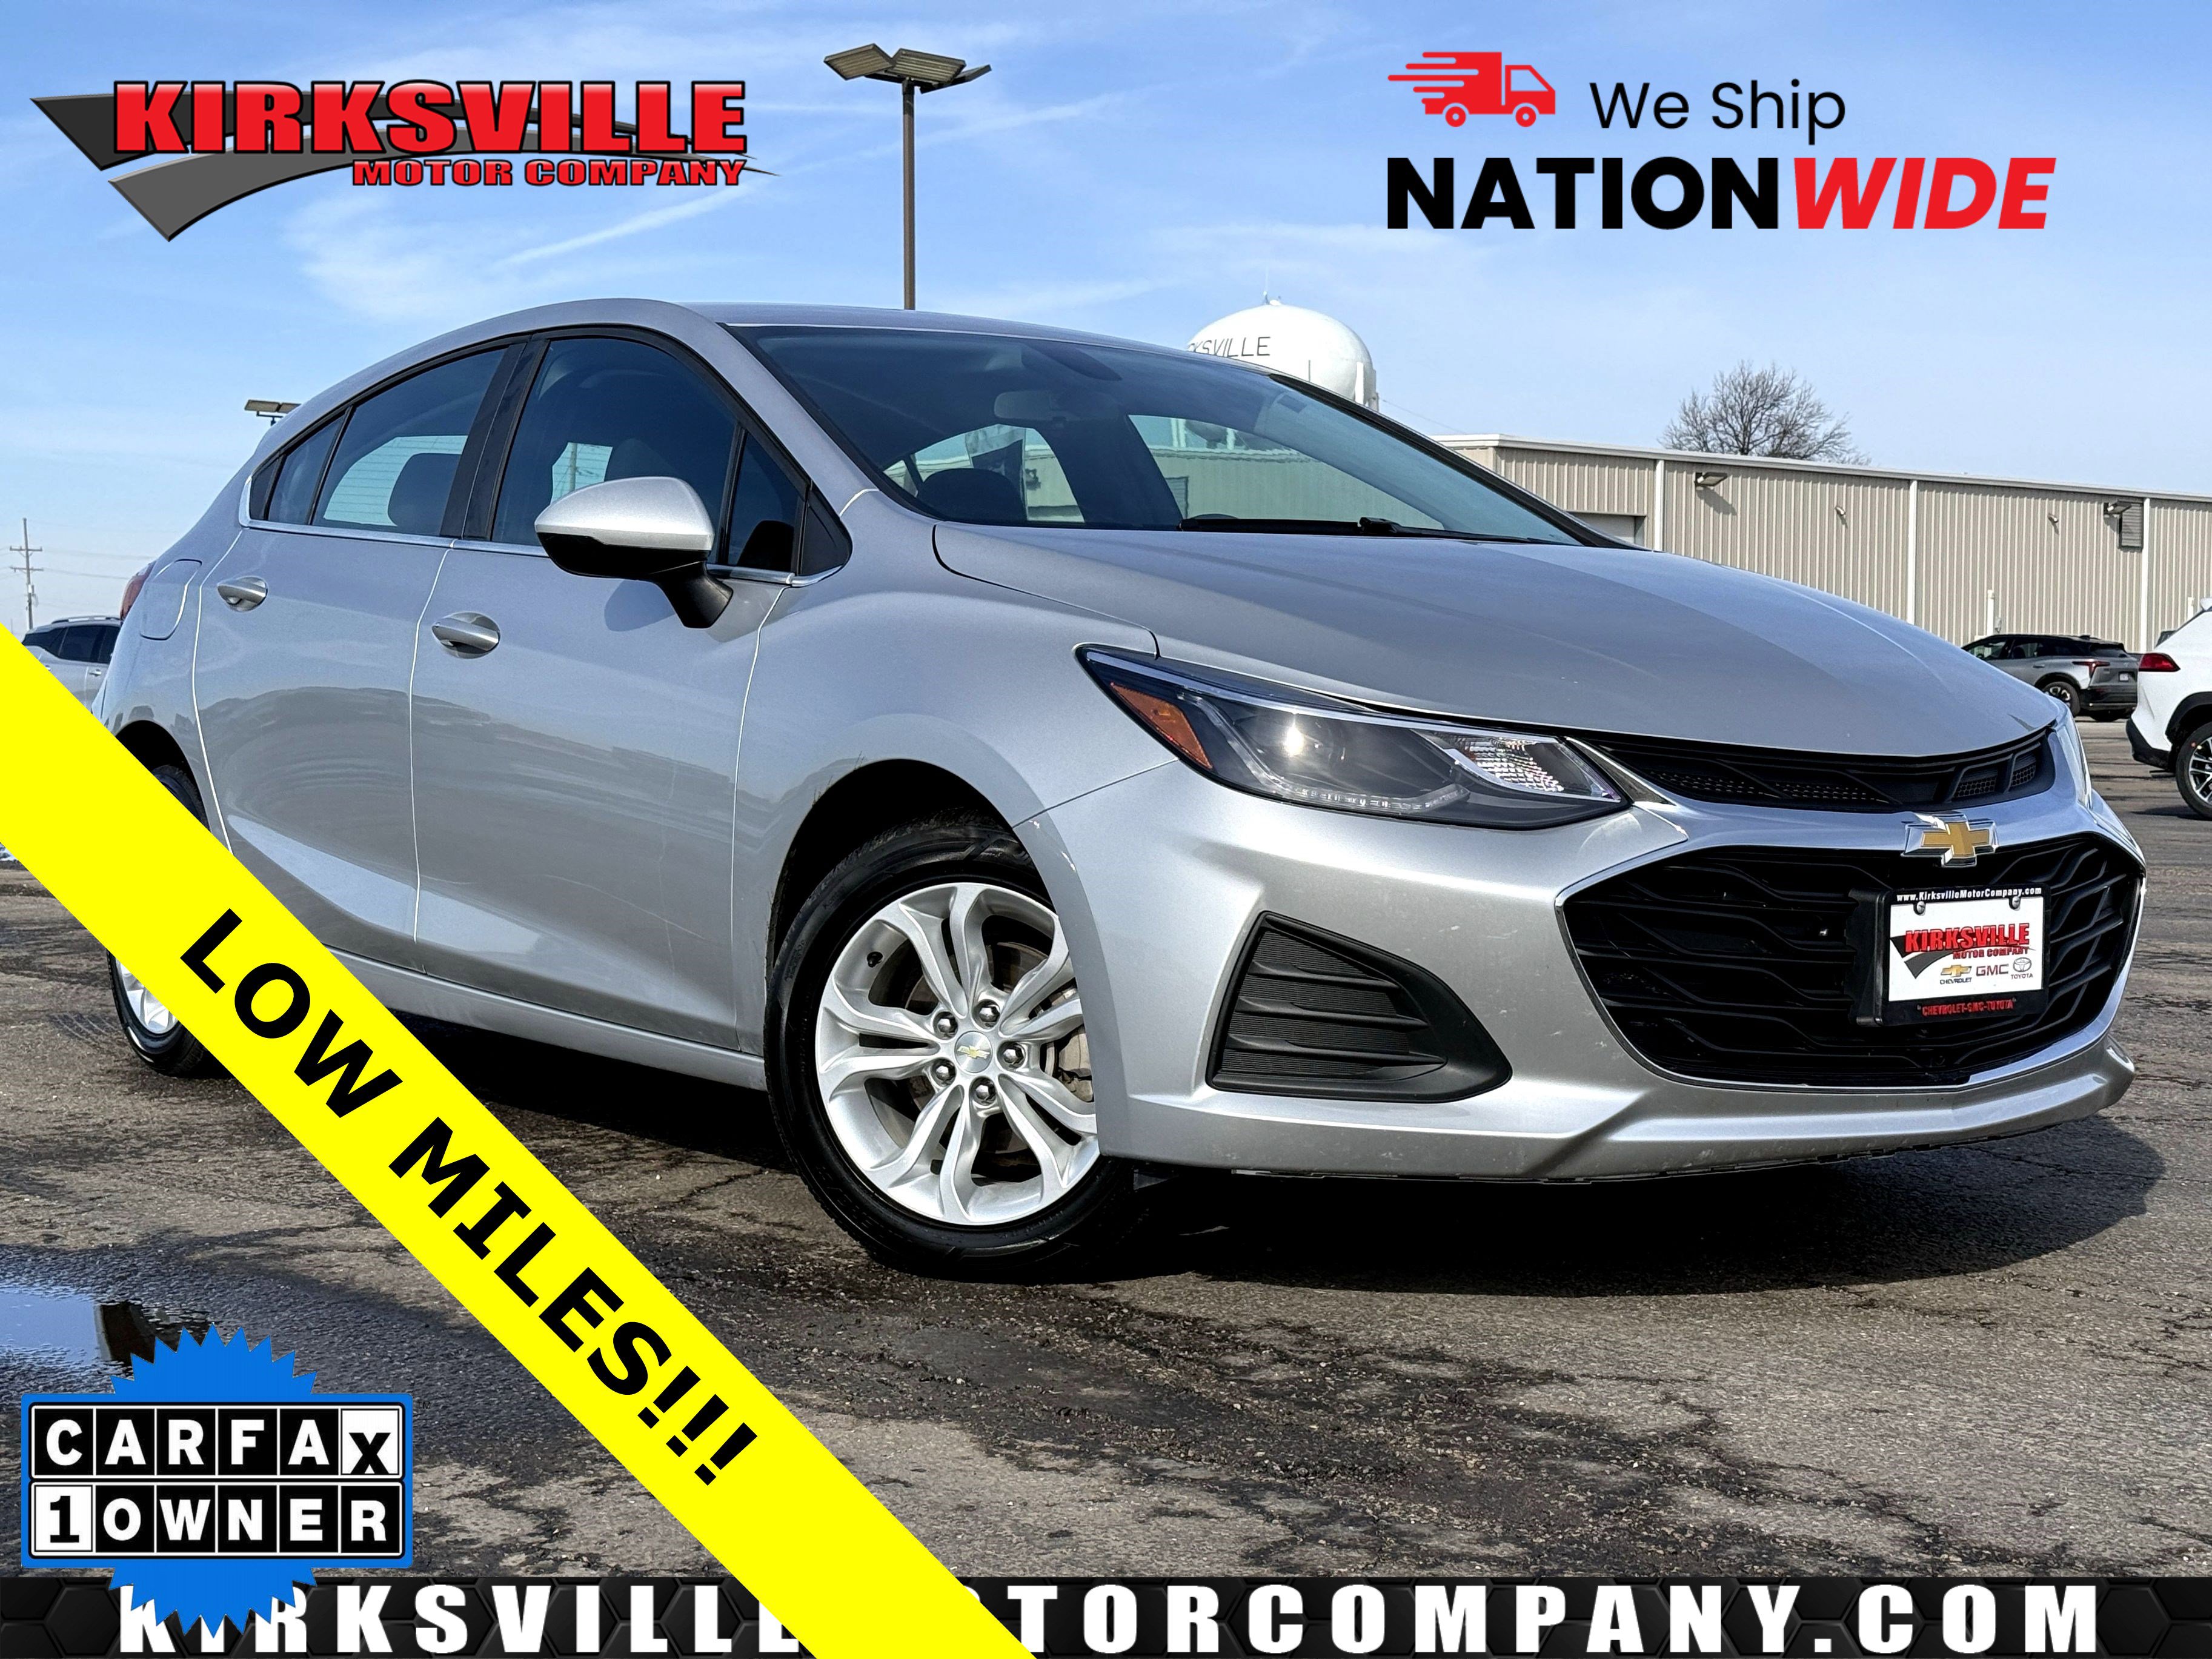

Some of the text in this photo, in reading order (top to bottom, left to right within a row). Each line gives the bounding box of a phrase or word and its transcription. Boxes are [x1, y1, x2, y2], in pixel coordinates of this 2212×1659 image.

[1905, 923, 2030, 953] KIRKSVILLE
[1953, 946, 2029, 959] MOTOR COMPANY
[1976, 965, 2008, 976] GMC
